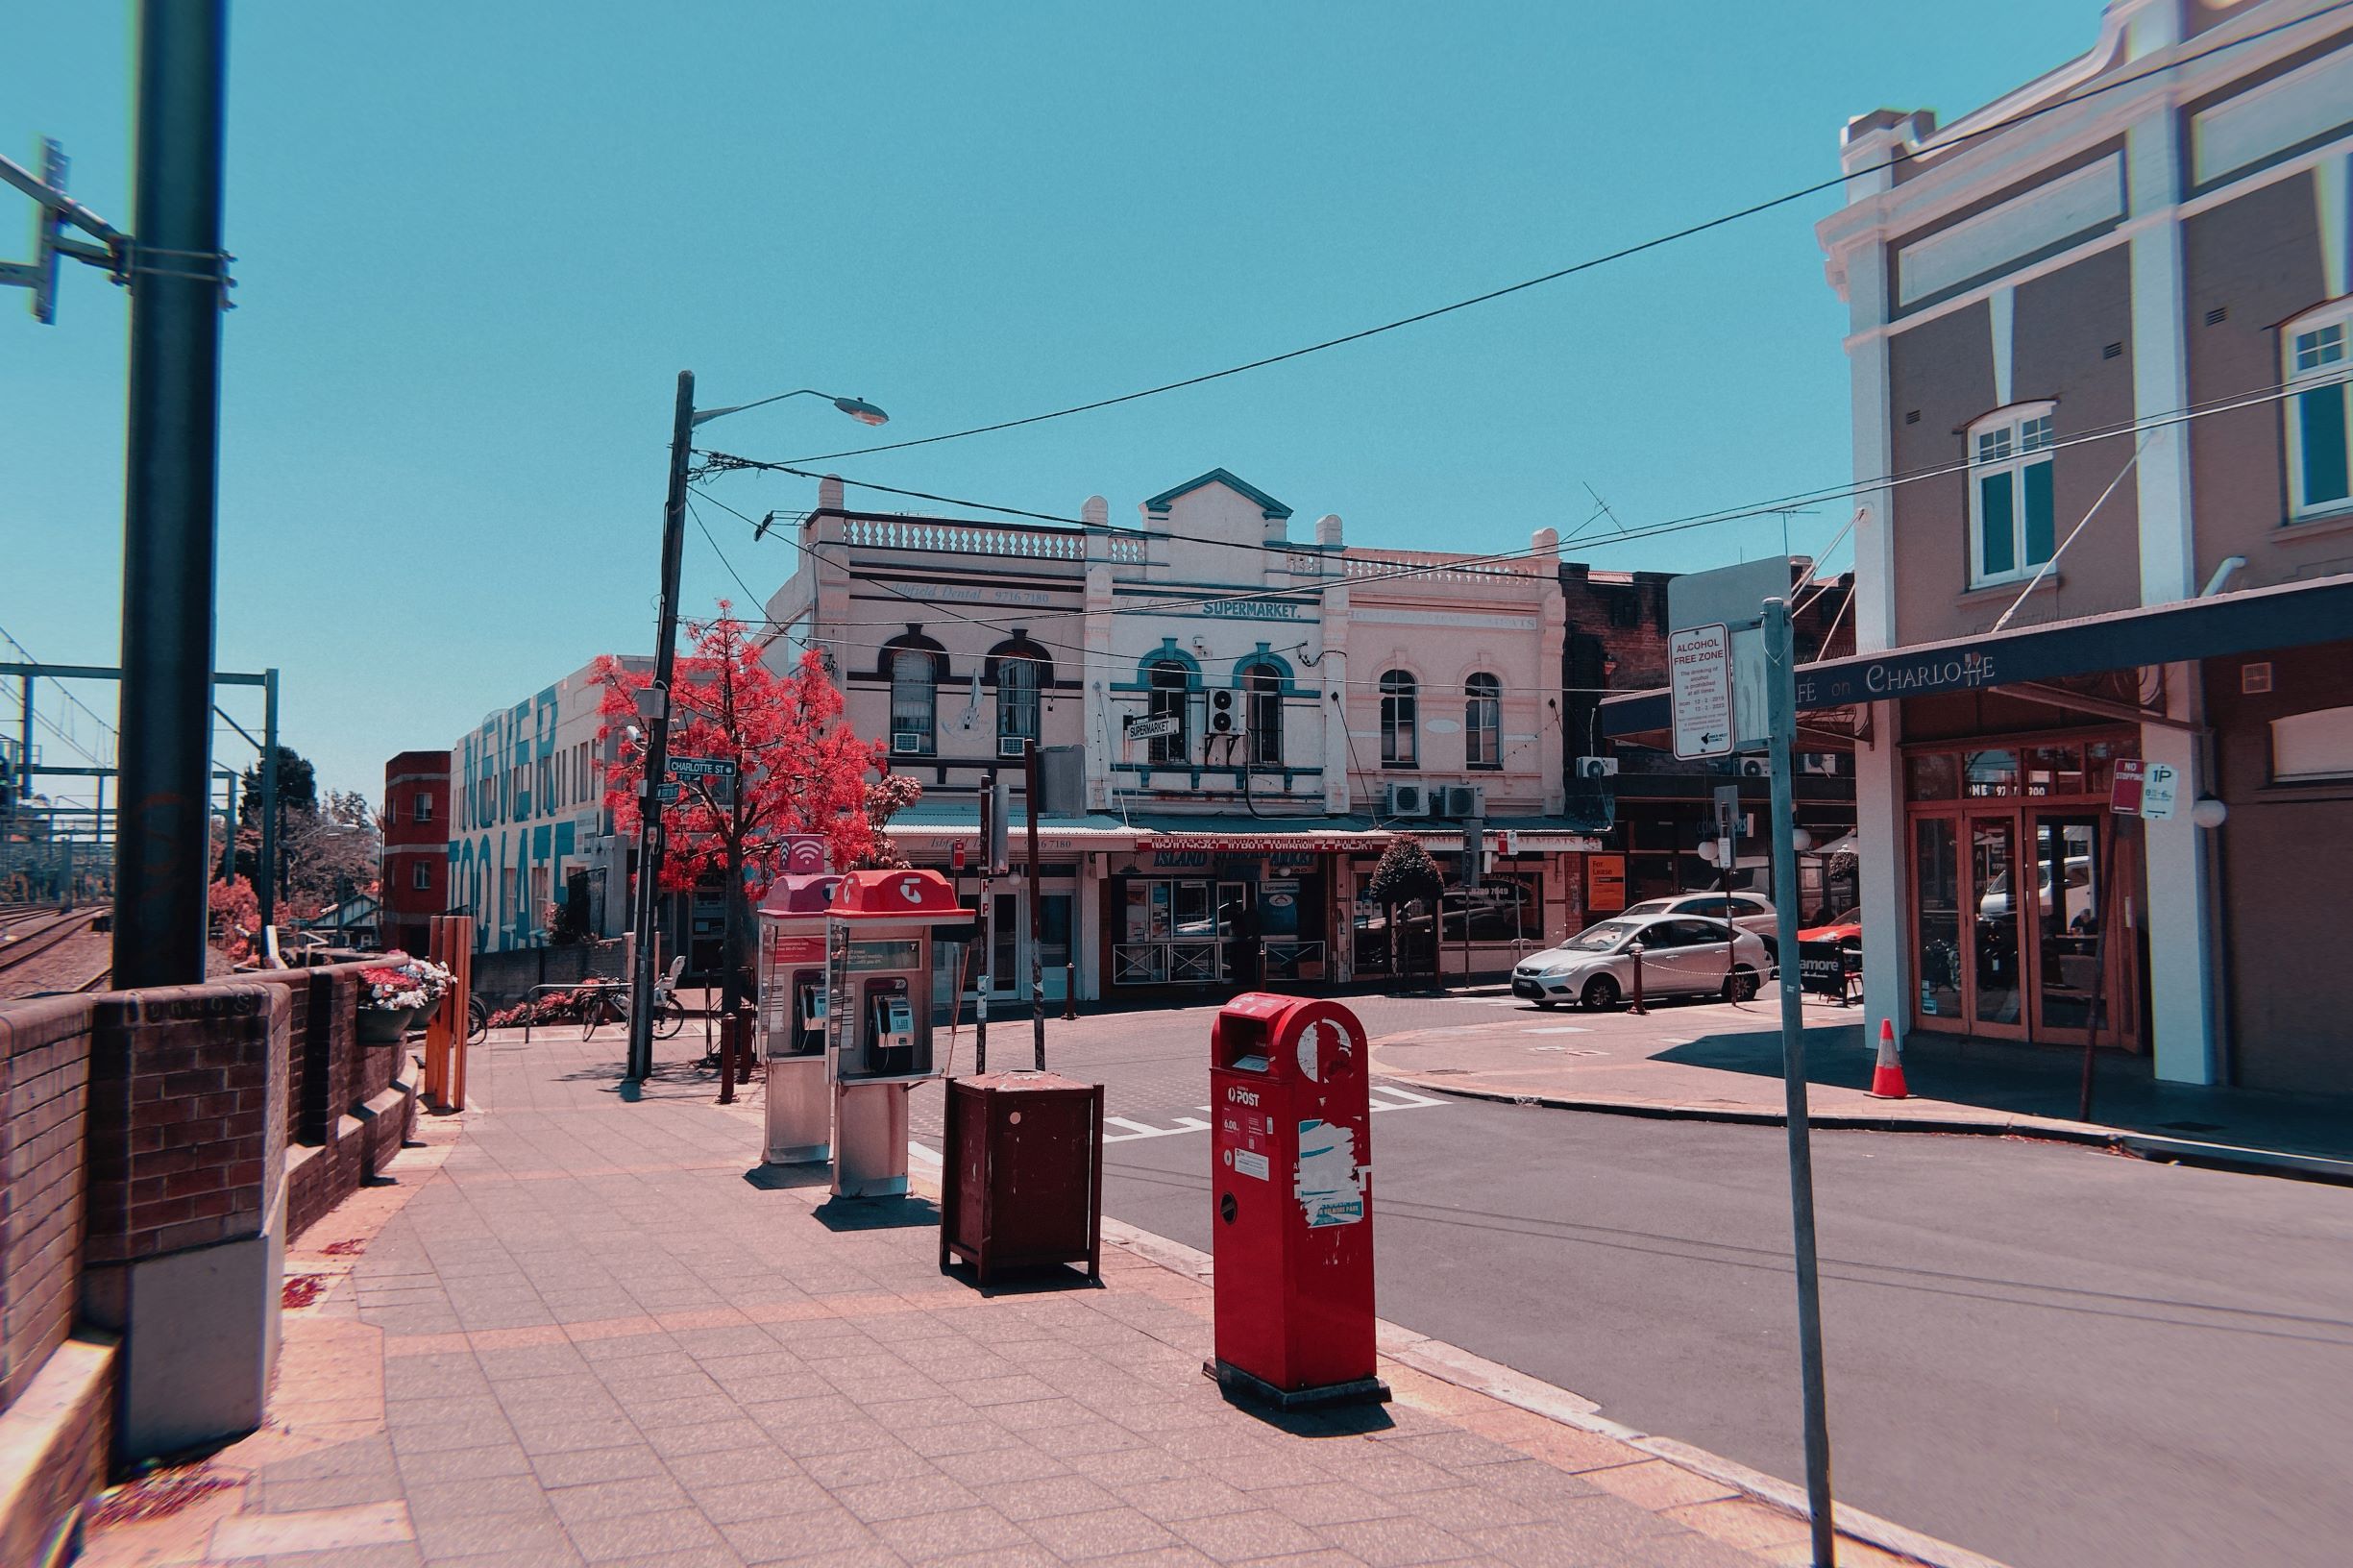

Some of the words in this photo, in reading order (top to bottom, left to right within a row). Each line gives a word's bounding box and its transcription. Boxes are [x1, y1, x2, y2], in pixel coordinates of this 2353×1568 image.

[942, 585, 982, 600] Dental
[1024, 594, 1049, 602] 7180
[1677, 639, 1720, 653] ALCOHOL
[1674, 654, 1697, 666] FREE
[1698, 649, 1725, 662] ZONE
[1796, 676, 1818, 703] FÉ
[1831, 681, 1851, 697] on
[1130, 721, 1170, 738] SUPERMARKET
[463, 684, 559, 833] NEVER
[2123, 761, 2137, 772] NO
[671, 761, 713, 773] CHARLOTTE
[714, 765, 725, 774] ST
[2153, 769, 2172, 783] 1P
[1536, 837, 1577, 846] MEATS
[498, 820, 576, 953] LATE
[1237, 1090, 1260, 1107] POST
